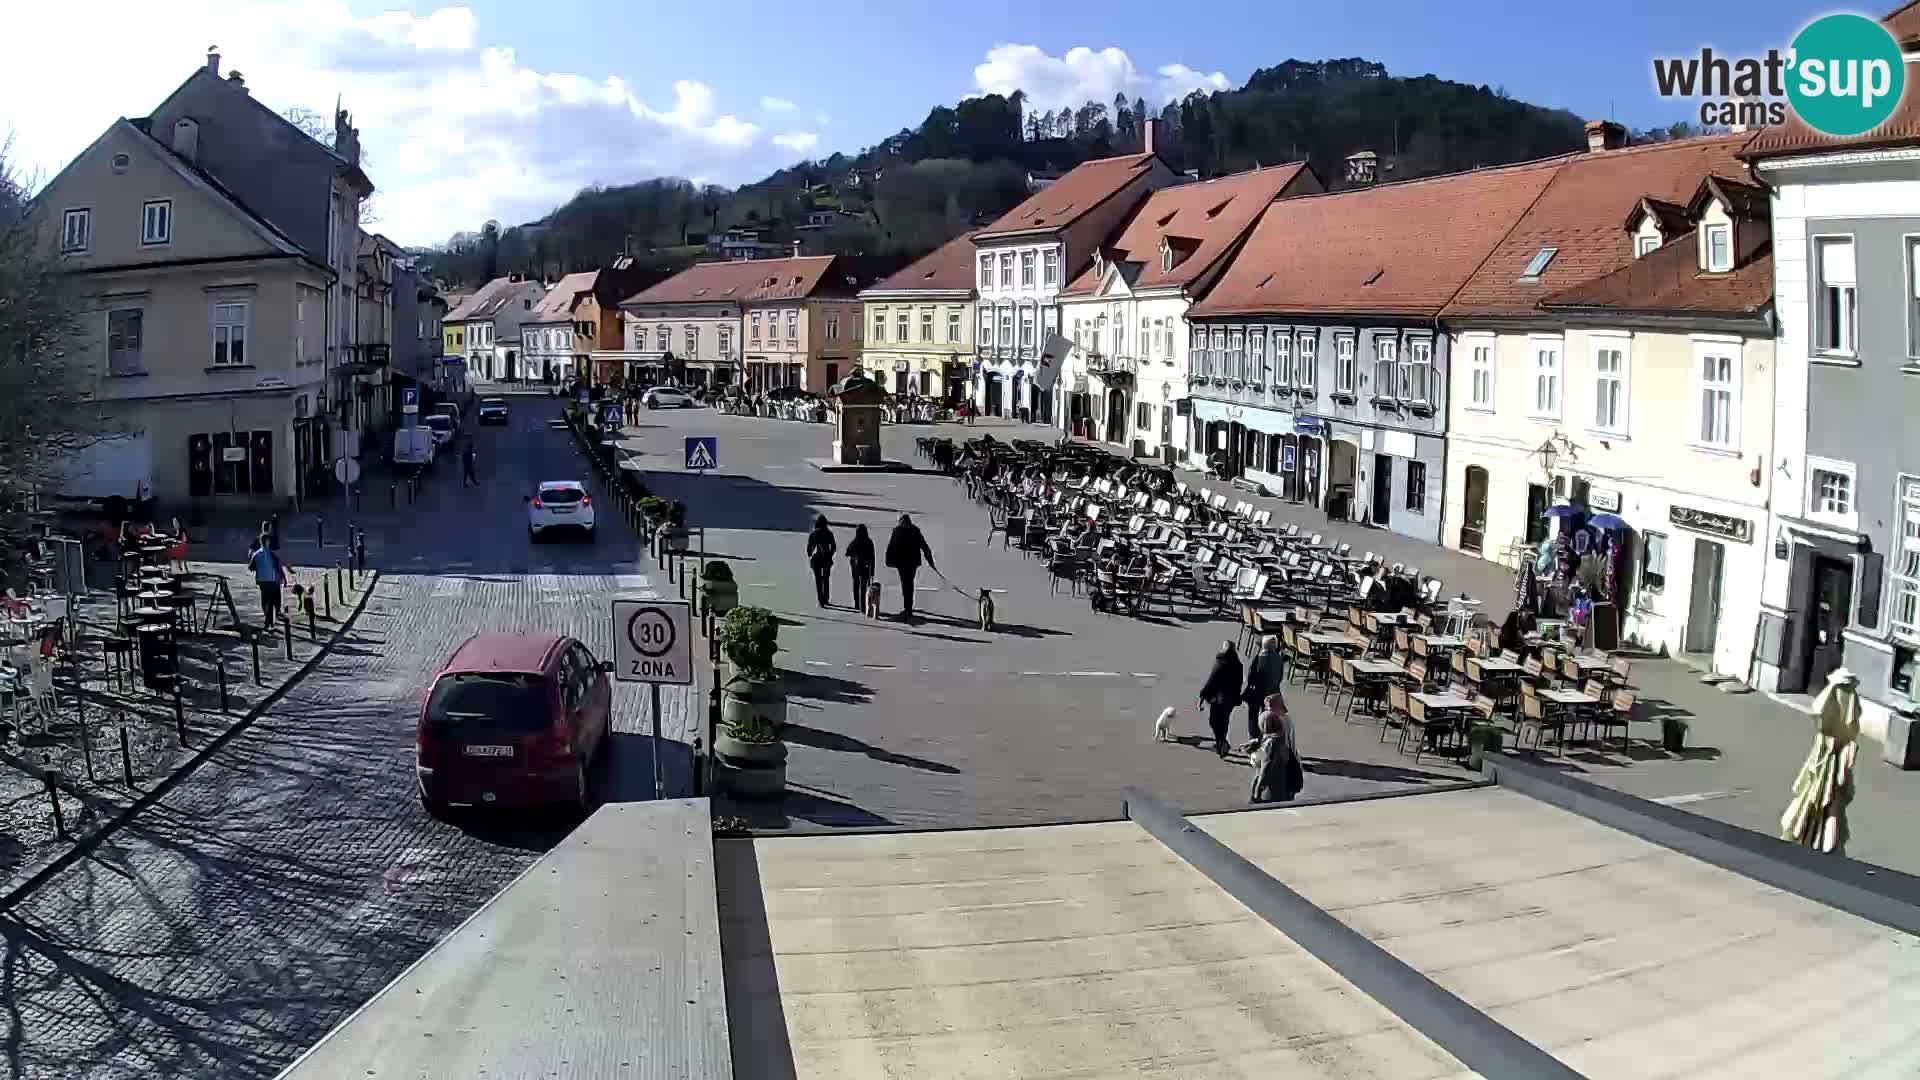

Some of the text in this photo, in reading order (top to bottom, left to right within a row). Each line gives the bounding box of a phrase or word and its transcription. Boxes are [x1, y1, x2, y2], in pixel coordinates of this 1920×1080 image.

[407, 391, 415, 404] P
[641, 623, 664, 644] 30
[631, 660, 675, 677] ZONA
